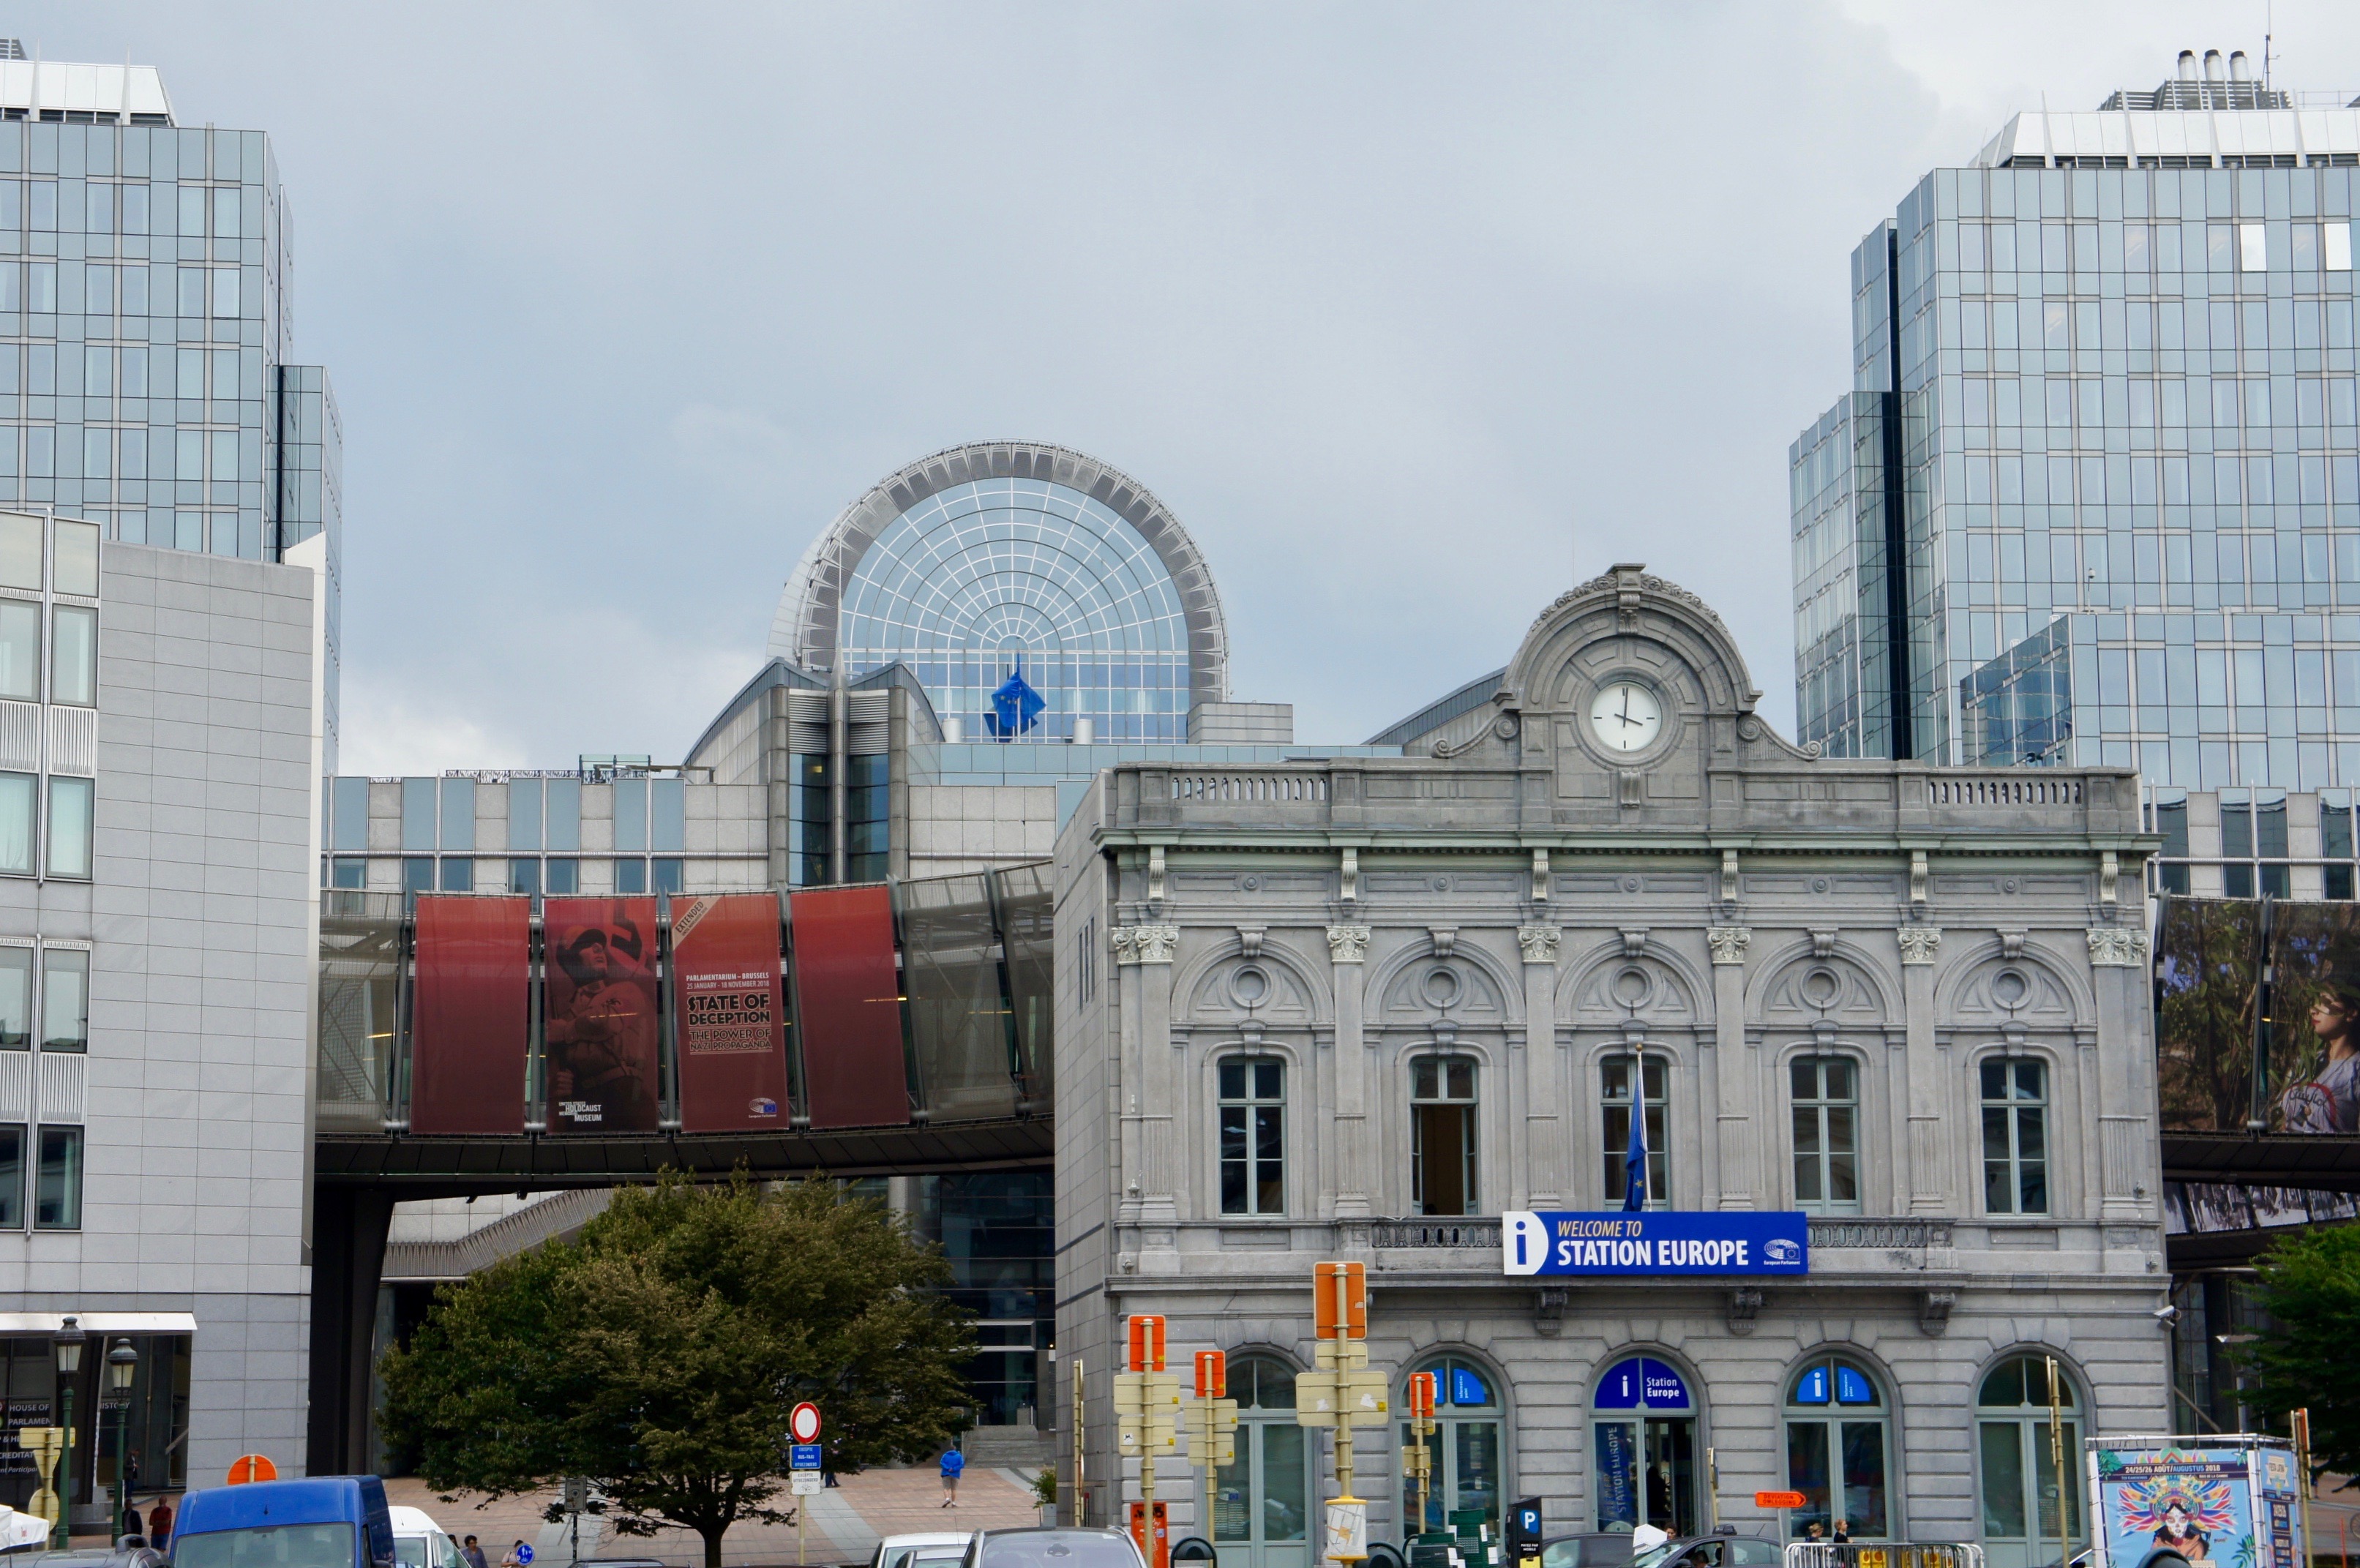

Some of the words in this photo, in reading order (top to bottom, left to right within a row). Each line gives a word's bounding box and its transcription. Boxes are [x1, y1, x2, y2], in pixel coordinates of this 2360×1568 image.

[675, 901, 704, 933] EXTENDED
[687, 994, 740, 1013] STATE
[743, 993, 770, 1010] OF
[689, 1010, 771, 1026] DECEPTION
[689, 1029, 711, 1041] THE
[713, 1028, 753, 1040] POWER
[755, 1027, 772, 1039] OF
[690, 1040, 711, 1051] NAZI
[713, 1038, 772, 1051] PROPAGANDA
[565, 1104, 602, 1112] HOLOCAUST
[574, 1114, 602, 1122] MUSEUM
[1558, 1220, 1623, 1237] WELCOME
[1625, 1220, 1642, 1237] TO
[1558, 1240, 1652, 1266] STATION
[1658, 1239, 1748, 1266] EUROPE
[1647, 1377, 1677, 1387] Station
[1647, 1387, 1679, 1399] Europe
[1608, 1426, 1621, 1468] EUROPE
[1613, 1471, 1626, 1513] STATION
[1524, 1512, 1536, 1529] P
